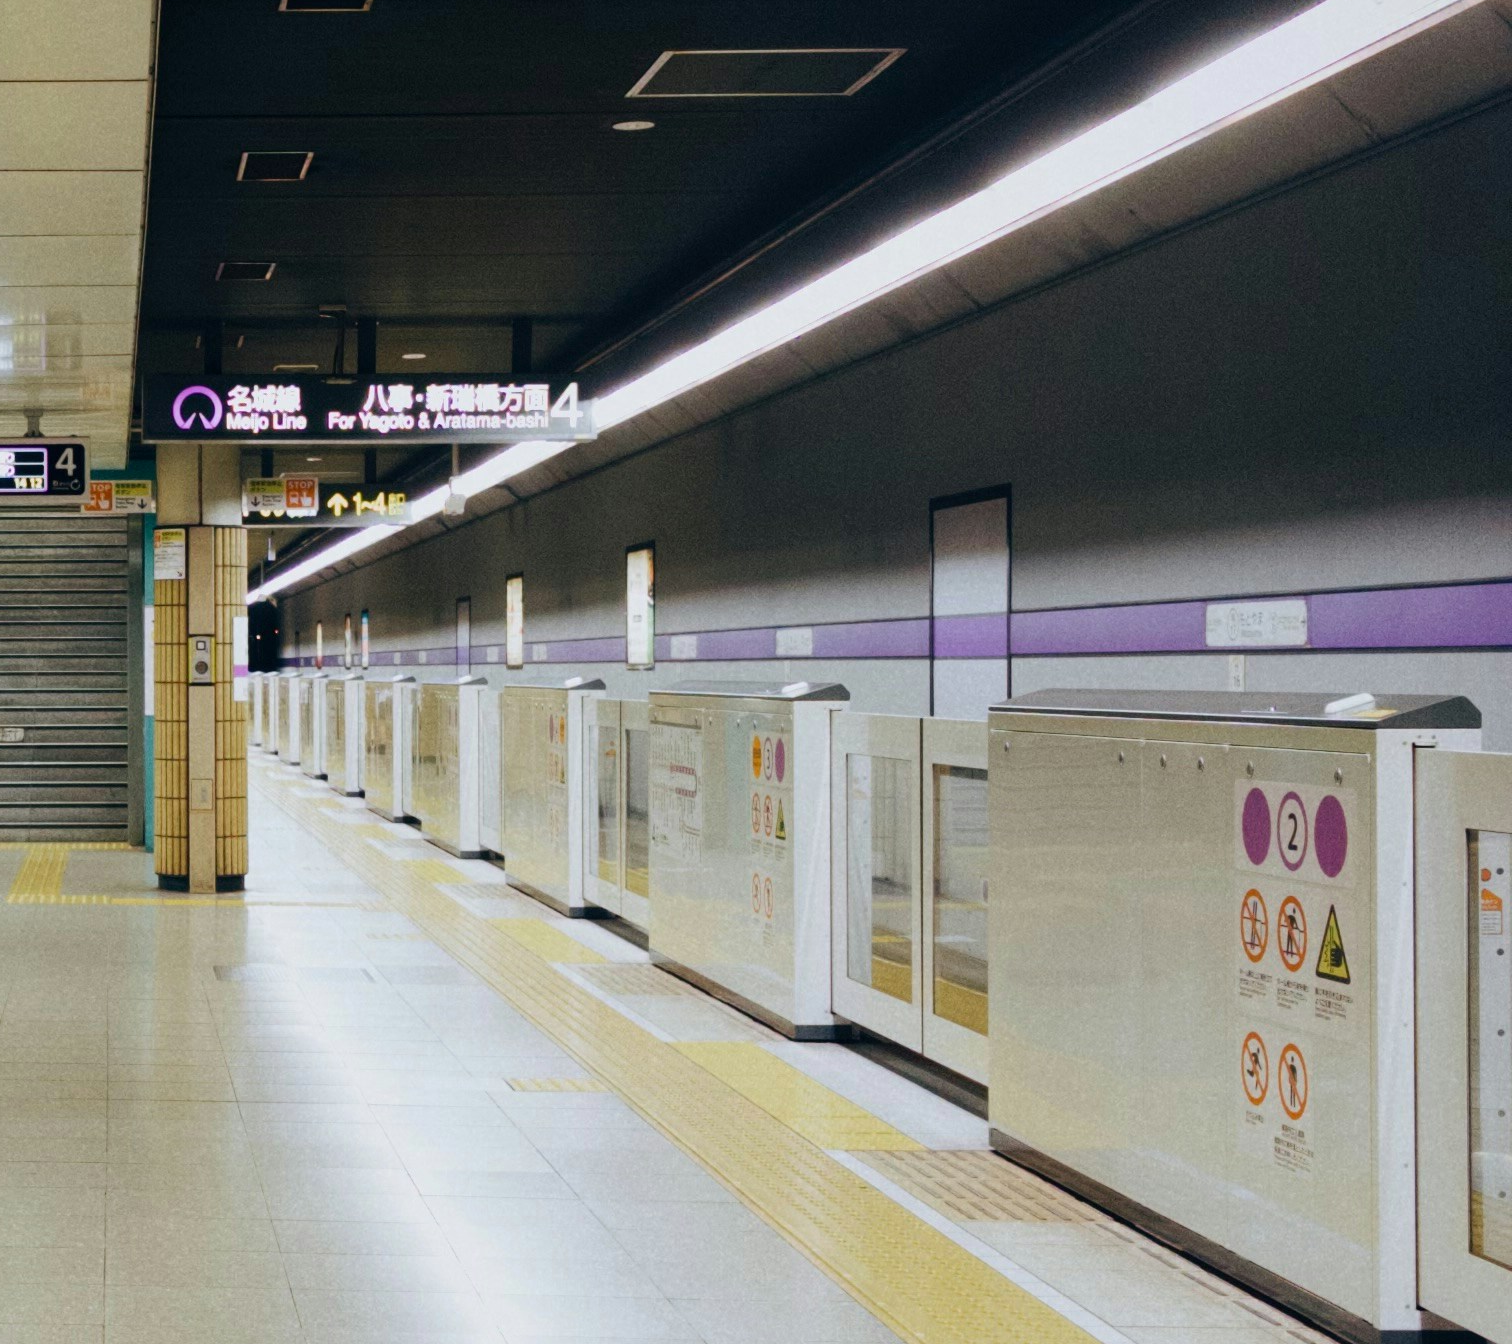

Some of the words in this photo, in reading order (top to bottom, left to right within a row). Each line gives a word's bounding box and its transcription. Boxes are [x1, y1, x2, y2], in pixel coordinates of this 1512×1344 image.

[227, 385, 301, 412] 名城線
[551, 382, 584, 428] 4
[226, 412, 269, 433] Meijo
[273, 413, 307, 430] Line
[328, 412, 356, 430] For
[359, 412, 414, 433] Yagoto
[418, 413, 430, 429] &
[433, 412, 549, 429] Aratama-bashi
[55, 448, 77, 476] 4
[288, 481, 313, 489] STOP
[1288, 813, 1298, 851] 2
